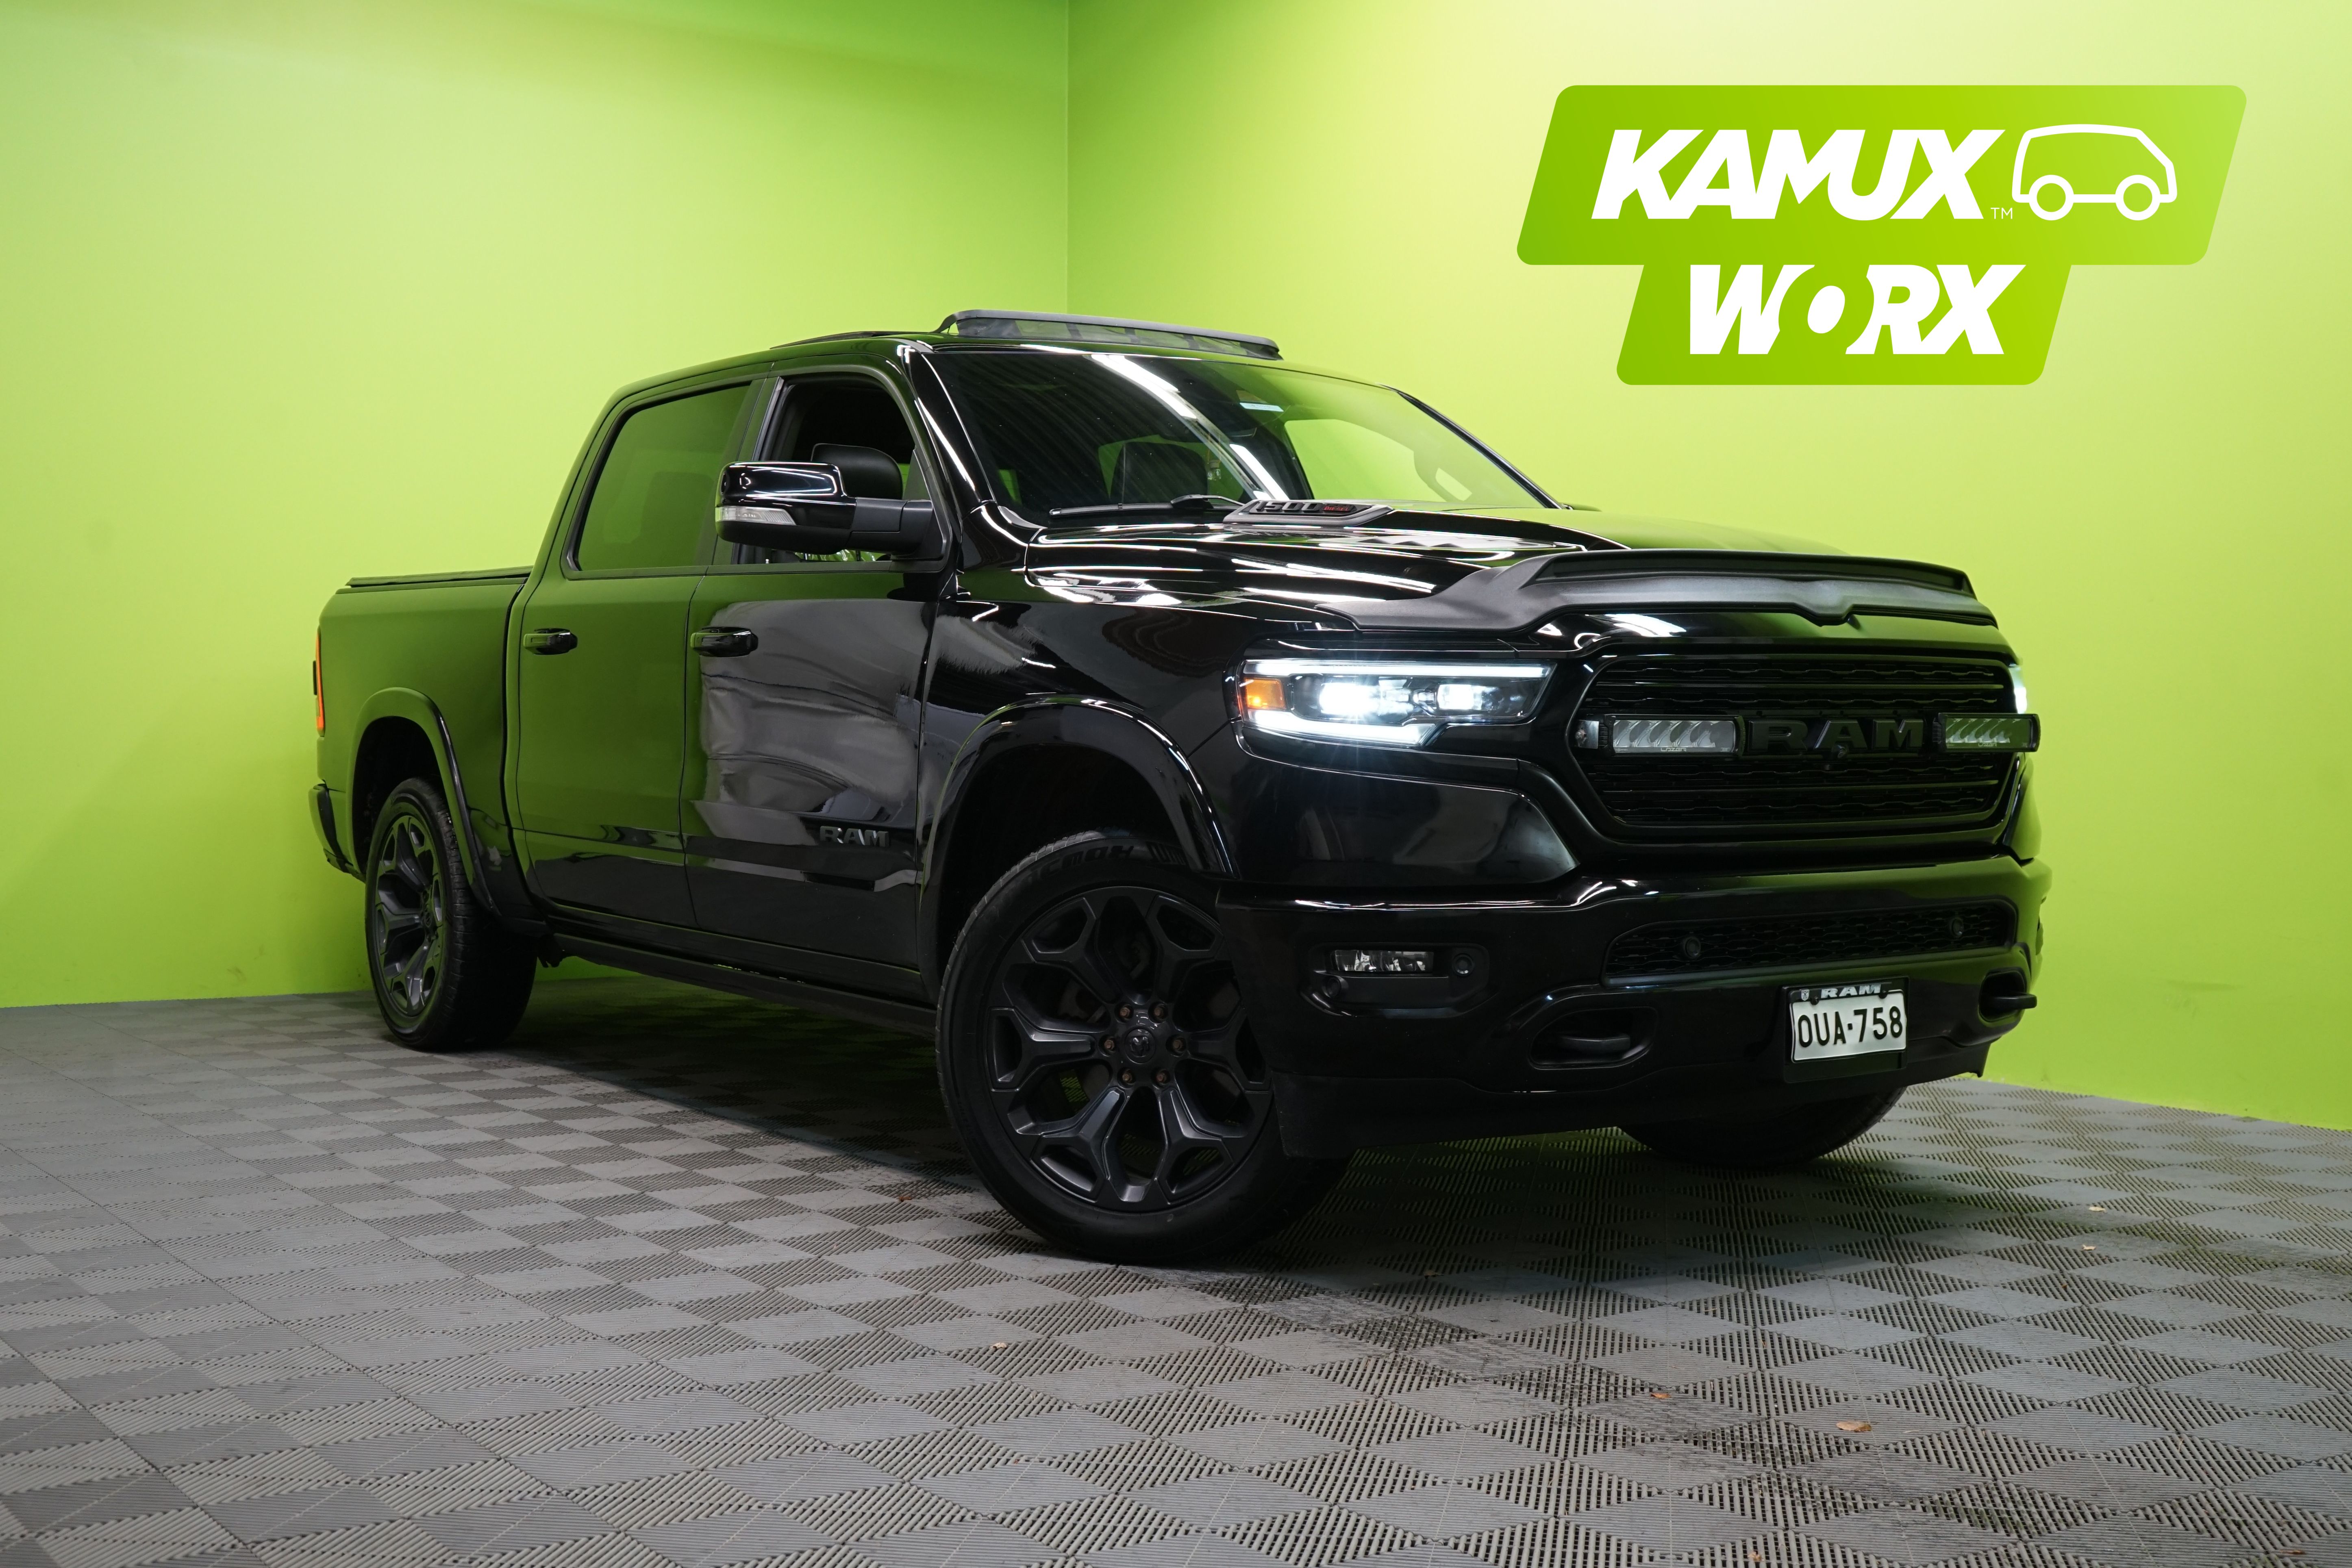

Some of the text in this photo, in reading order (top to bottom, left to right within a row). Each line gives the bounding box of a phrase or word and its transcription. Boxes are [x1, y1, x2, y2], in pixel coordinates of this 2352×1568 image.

[1256, 500, 1321, 511] 1500
[1748, 719, 1924, 751] RAM
[820, 825, 889, 847] RAM
[1821, 984, 1881, 999] RAM
[1798, 1006, 1903, 1048] OUA-758
